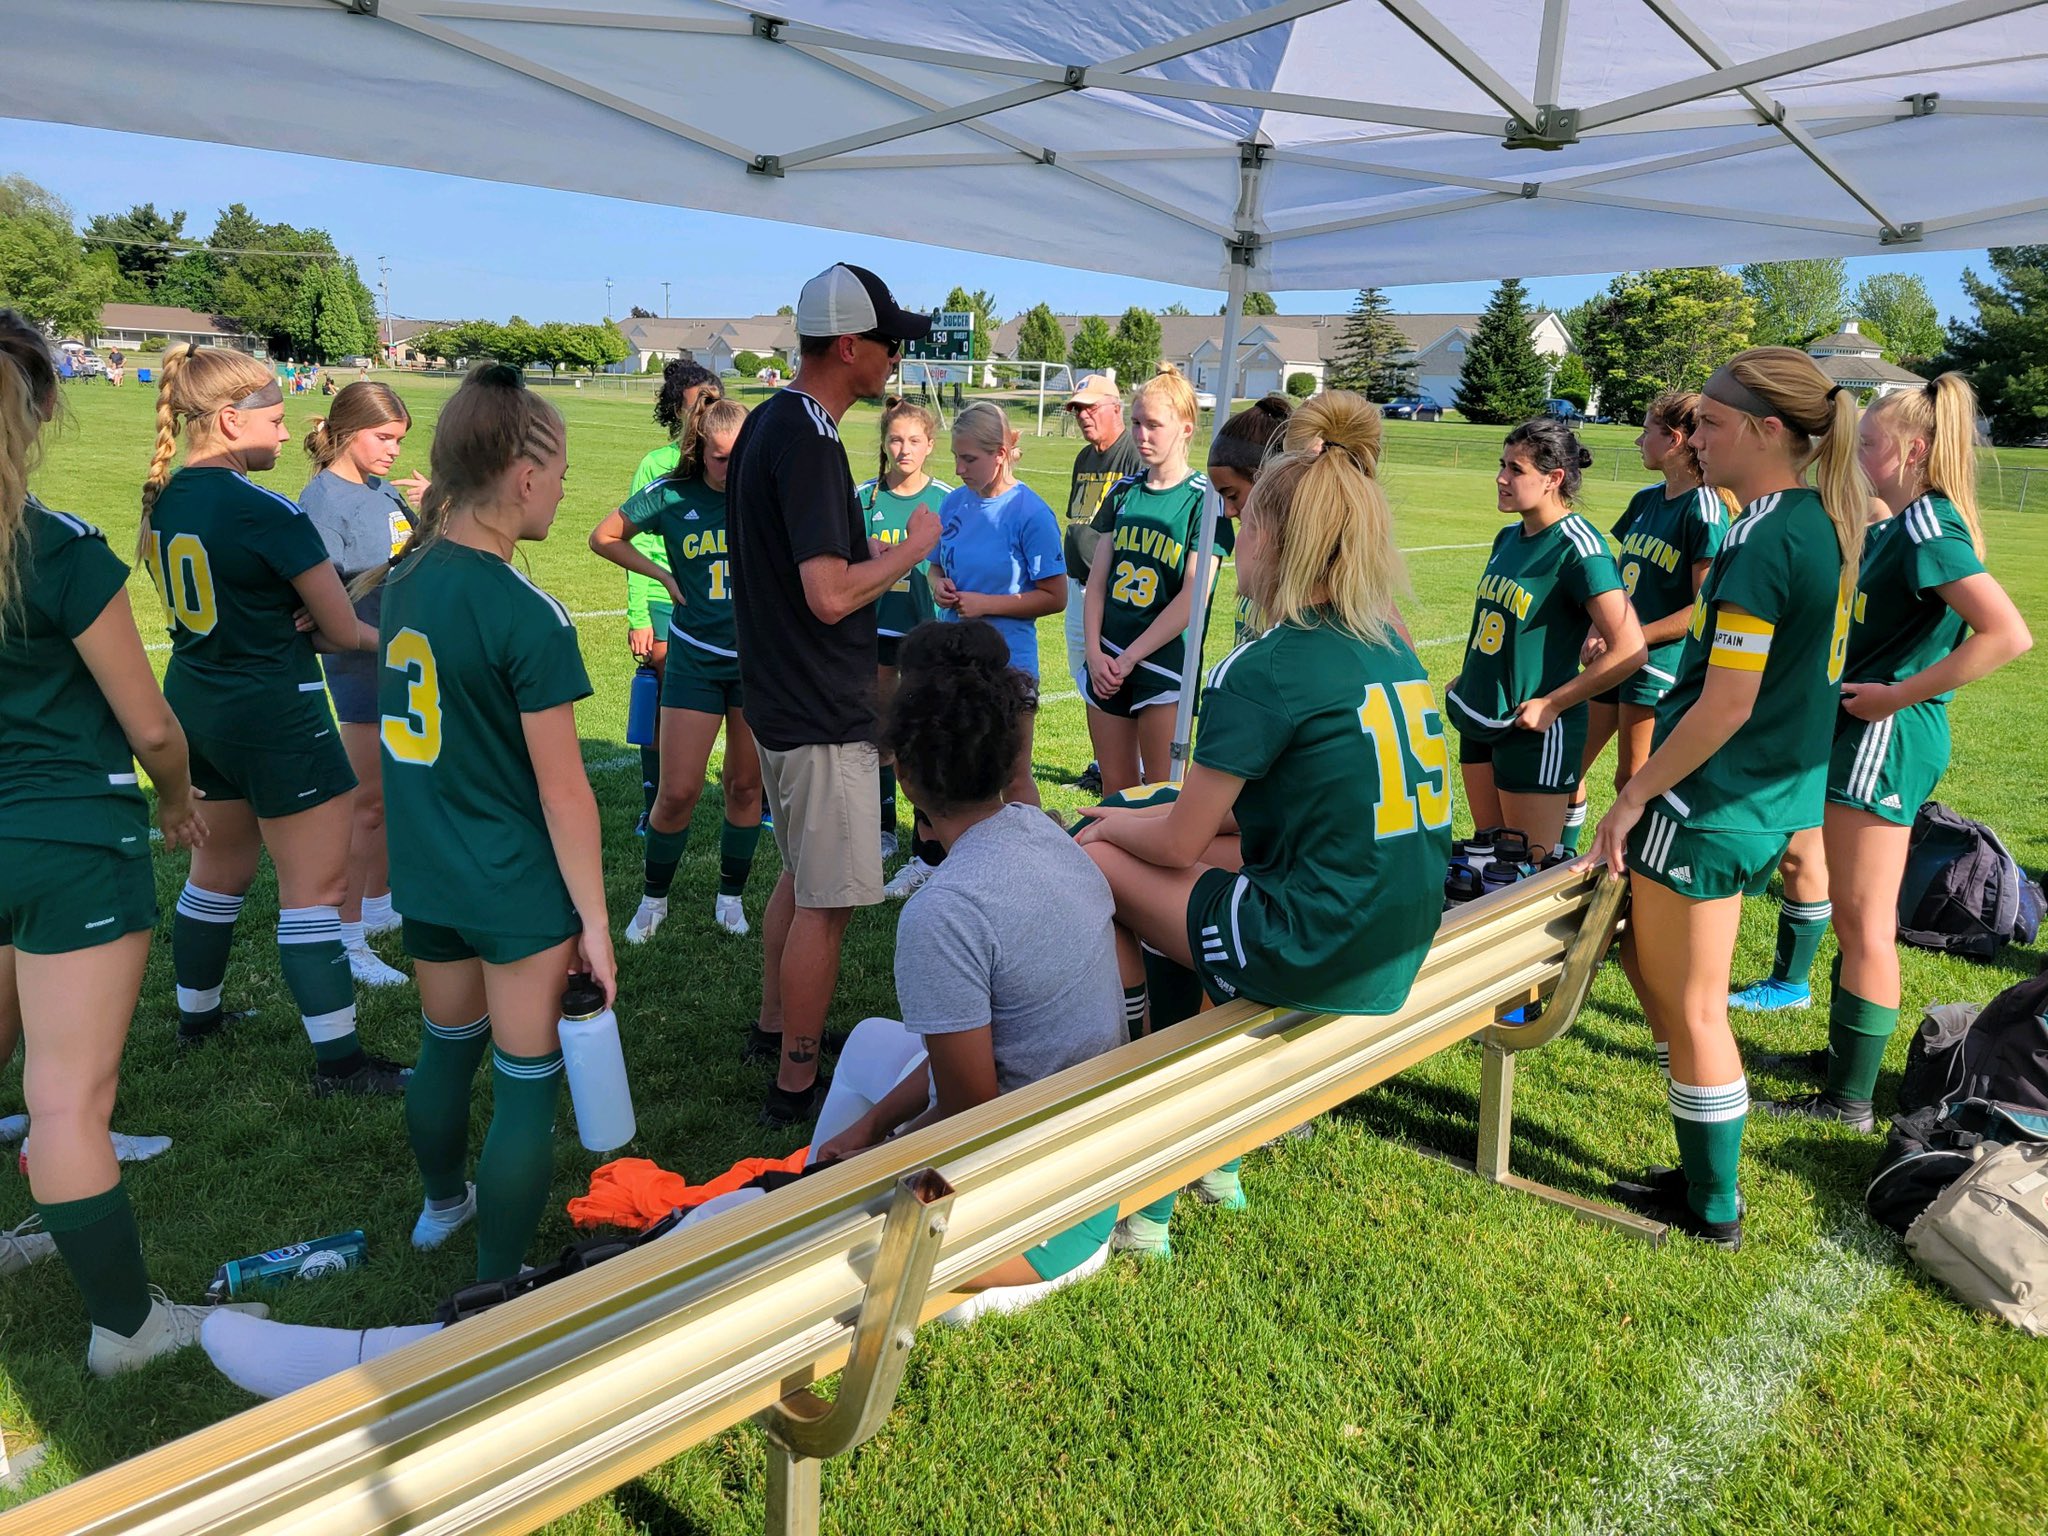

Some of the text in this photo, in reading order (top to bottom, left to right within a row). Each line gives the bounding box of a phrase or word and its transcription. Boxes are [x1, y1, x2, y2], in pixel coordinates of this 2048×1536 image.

[943, 315, 969, 327] SOCCER
[909, 341, 915, 352] 0
[963, 341, 968, 352] 0
[683, 529, 728, 559] CAL
[1622, 532, 1681, 574] ALVIN
[1112, 560, 1160, 608] 23
[1477, 574, 1534, 621] ALVIN
[1471, 608, 1506, 656] 18
[380, 626, 443, 767] 3
[1356, 679, 1454, 841] 15
